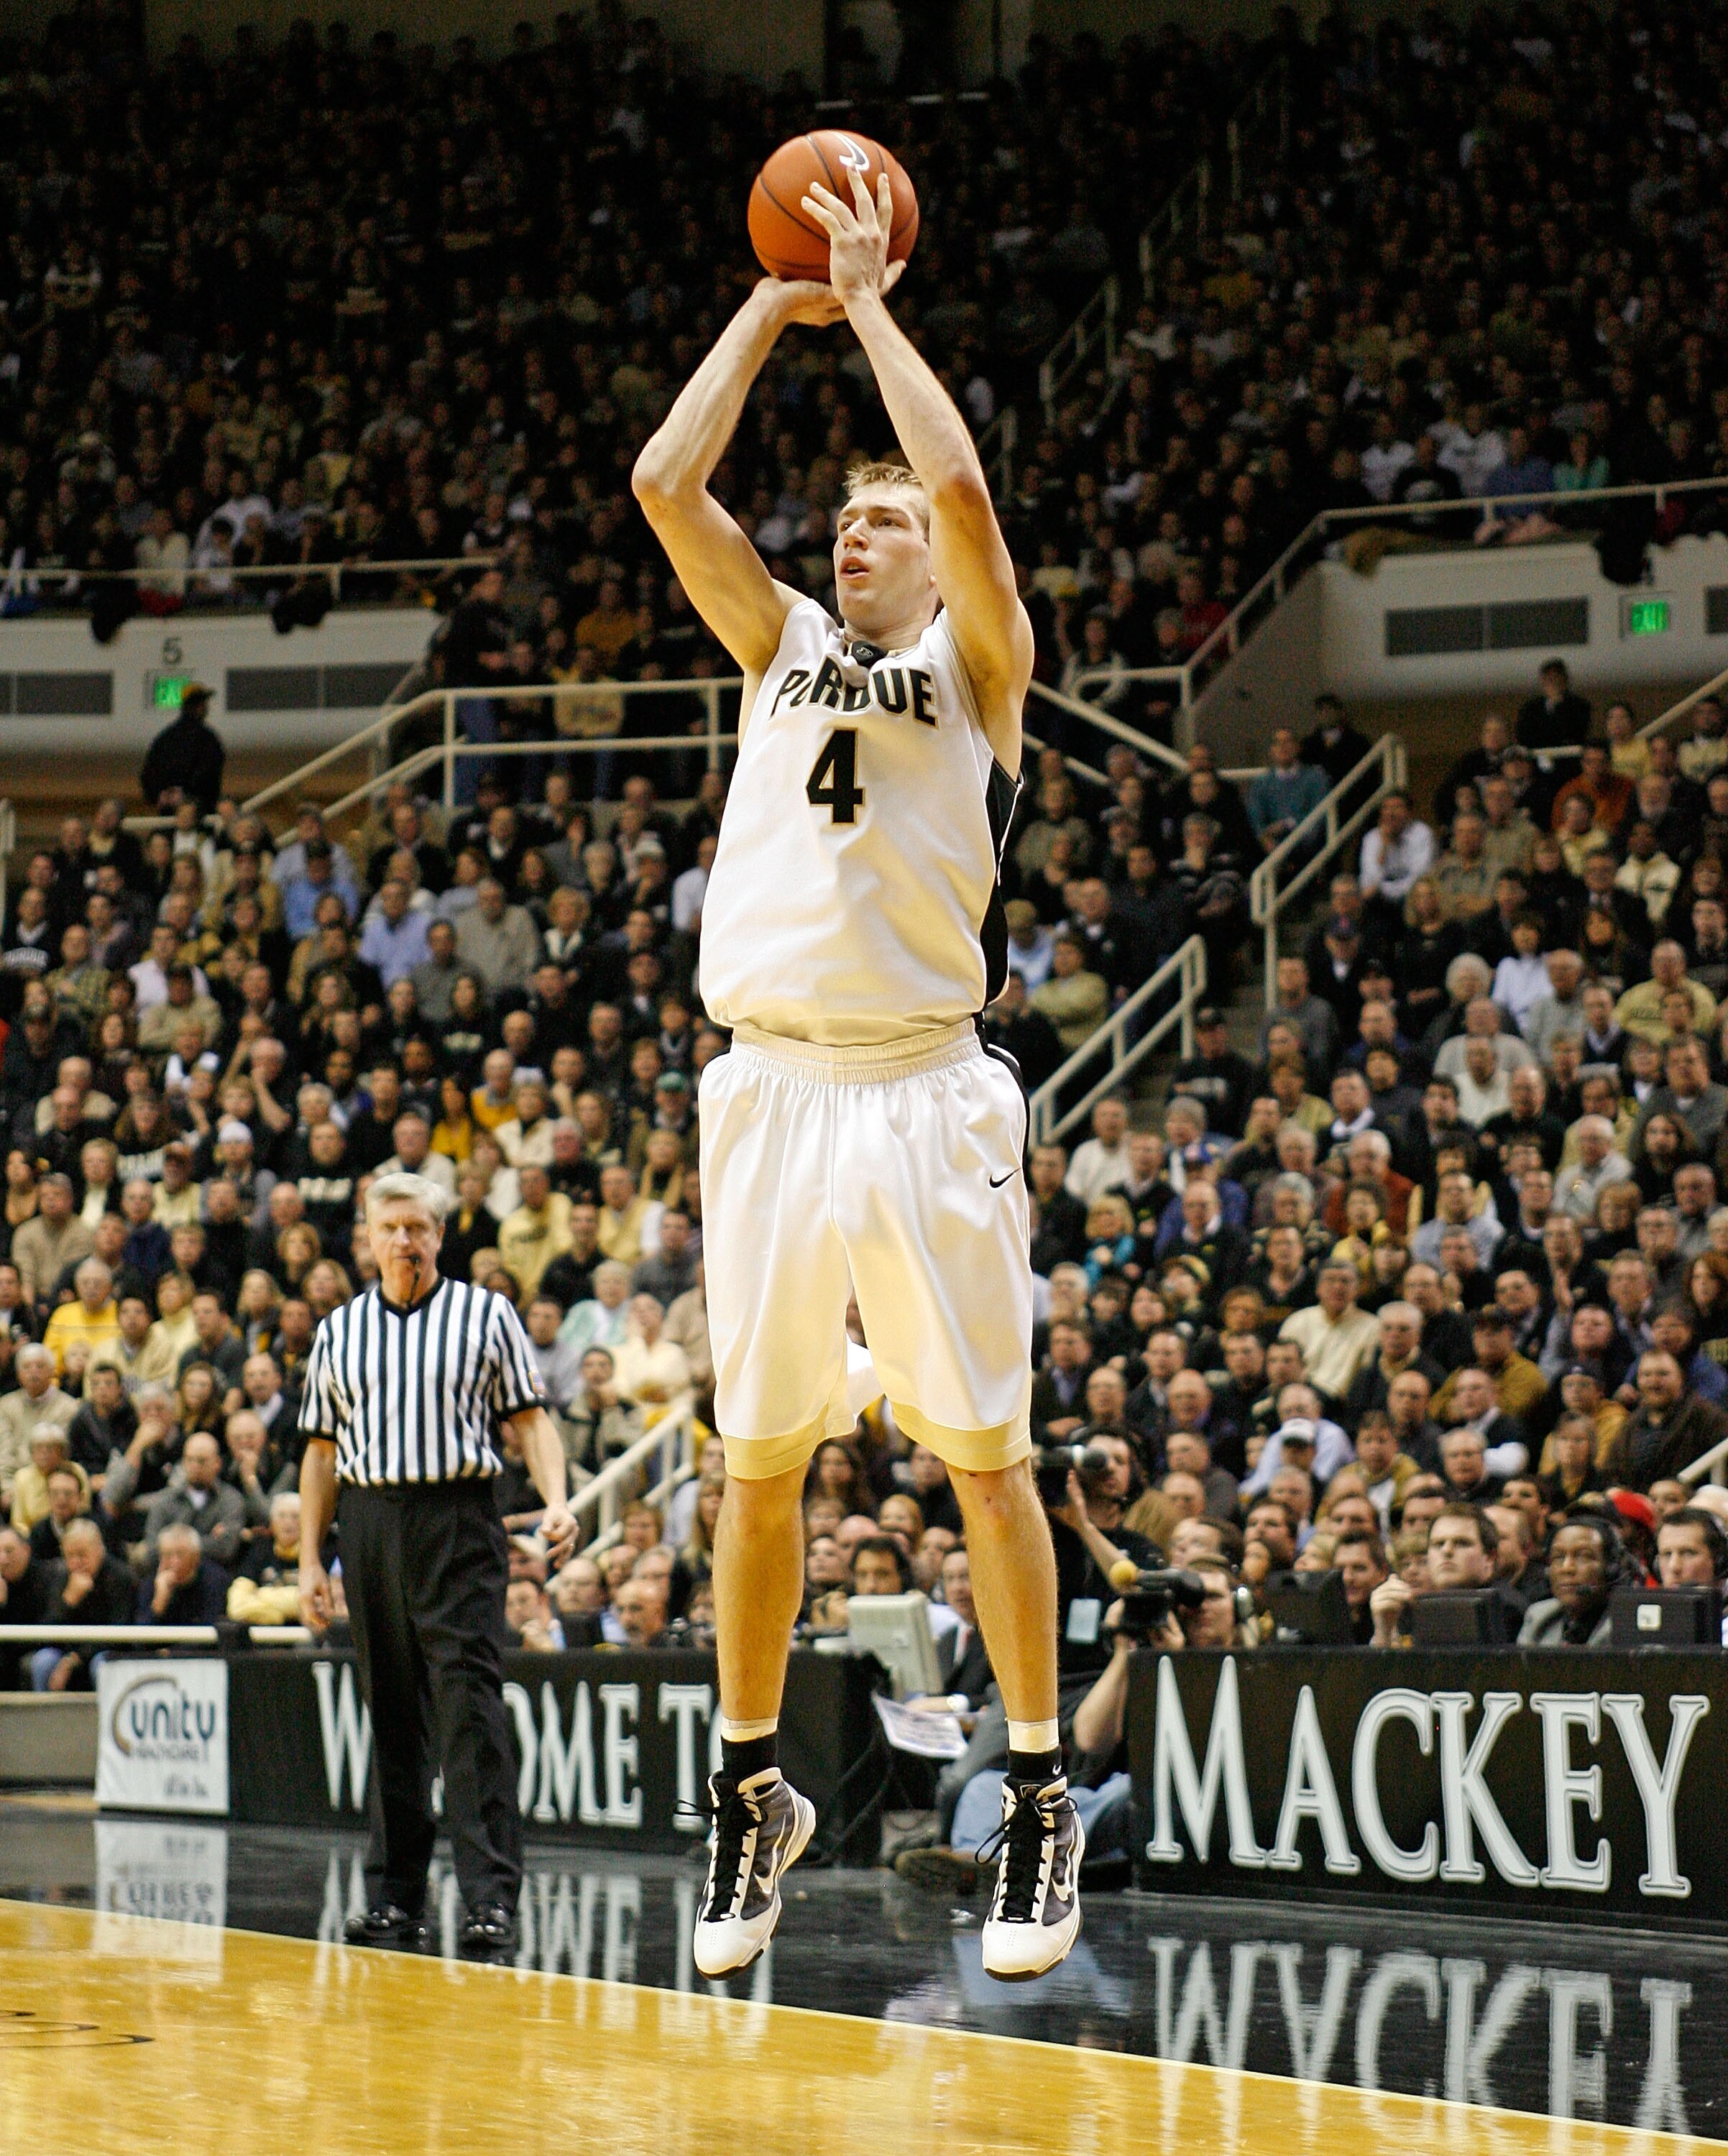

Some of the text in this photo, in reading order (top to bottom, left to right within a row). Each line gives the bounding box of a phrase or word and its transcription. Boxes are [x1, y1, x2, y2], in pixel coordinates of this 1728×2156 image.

[162, 637, 183, 665] 5
[806, 727, 866, 826] 4
[130, 1690, 216, 1761] unity
[658, 1682, 723, 1832] T
[1146, 1655, 1711, 1897] MACKEY
